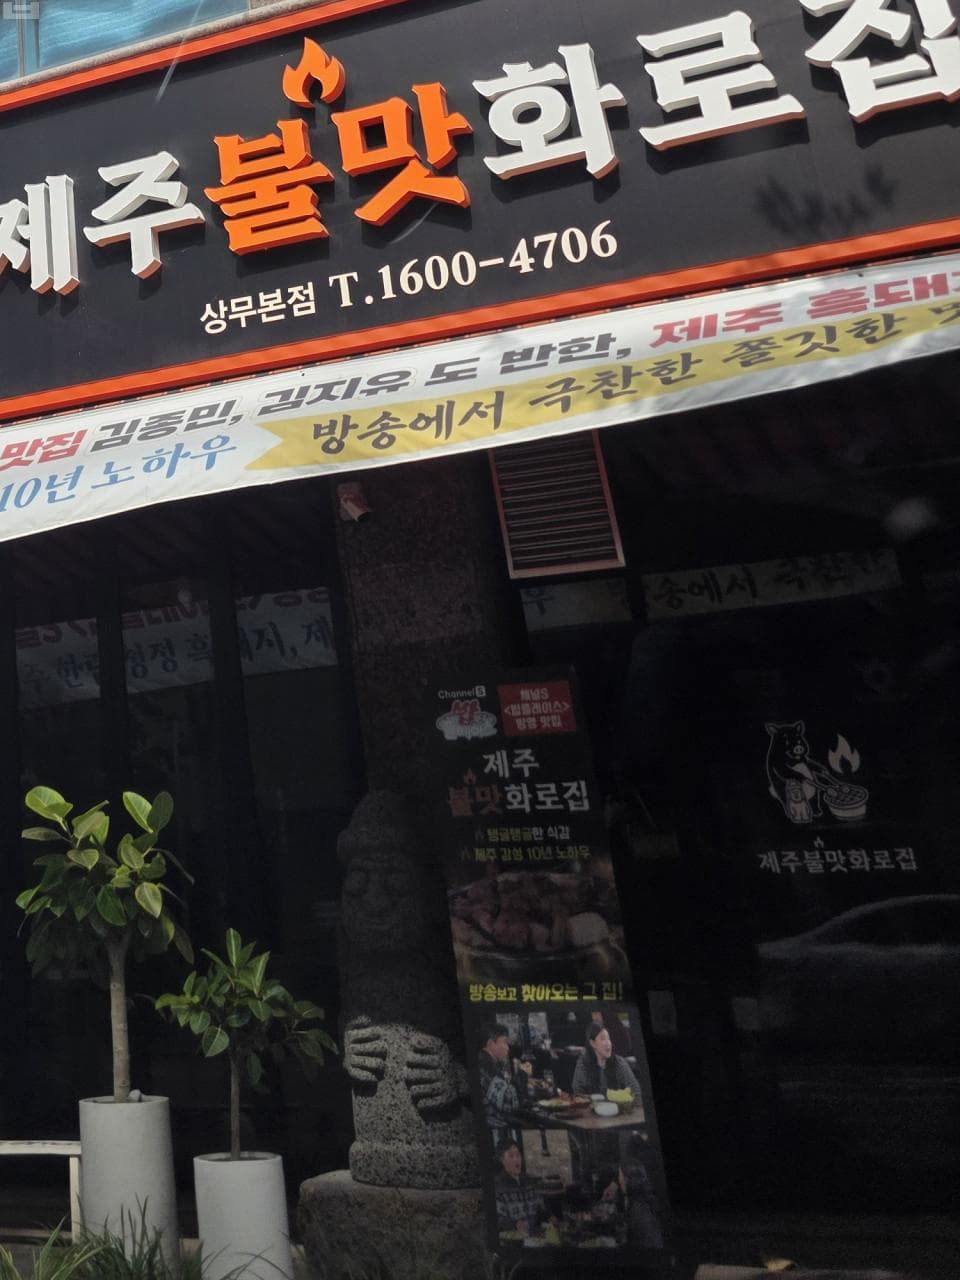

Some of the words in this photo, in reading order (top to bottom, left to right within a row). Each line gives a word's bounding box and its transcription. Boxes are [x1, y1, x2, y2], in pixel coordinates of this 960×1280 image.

[200, 281, 317, 334] 상무본점
[328, 220, 618, 308] T.1600-4706
[259, 371, 410, 416] 김지유
[426, 357, 480, 387] 도
[500, 332, 632, 375] 반한,
[649, 302, 784, 349] 제주
[91, 435, 237, 490] 노하우
[313, 391, 506, 455] 방송에서
[529, 351, 703, 414] 극찬한
[723, 312, 907, 368] 쫄깃한
[482, 748, 540, 779] 제주
[555, 844, 592, 860] 노하우
[756, 846, 919, 874] 제주불맛화로집
[469, 982, 518, 1002] 방송보고
[521, 982, 579, 1002] 찾아오는
[582, 981, 598, 1000] 그
